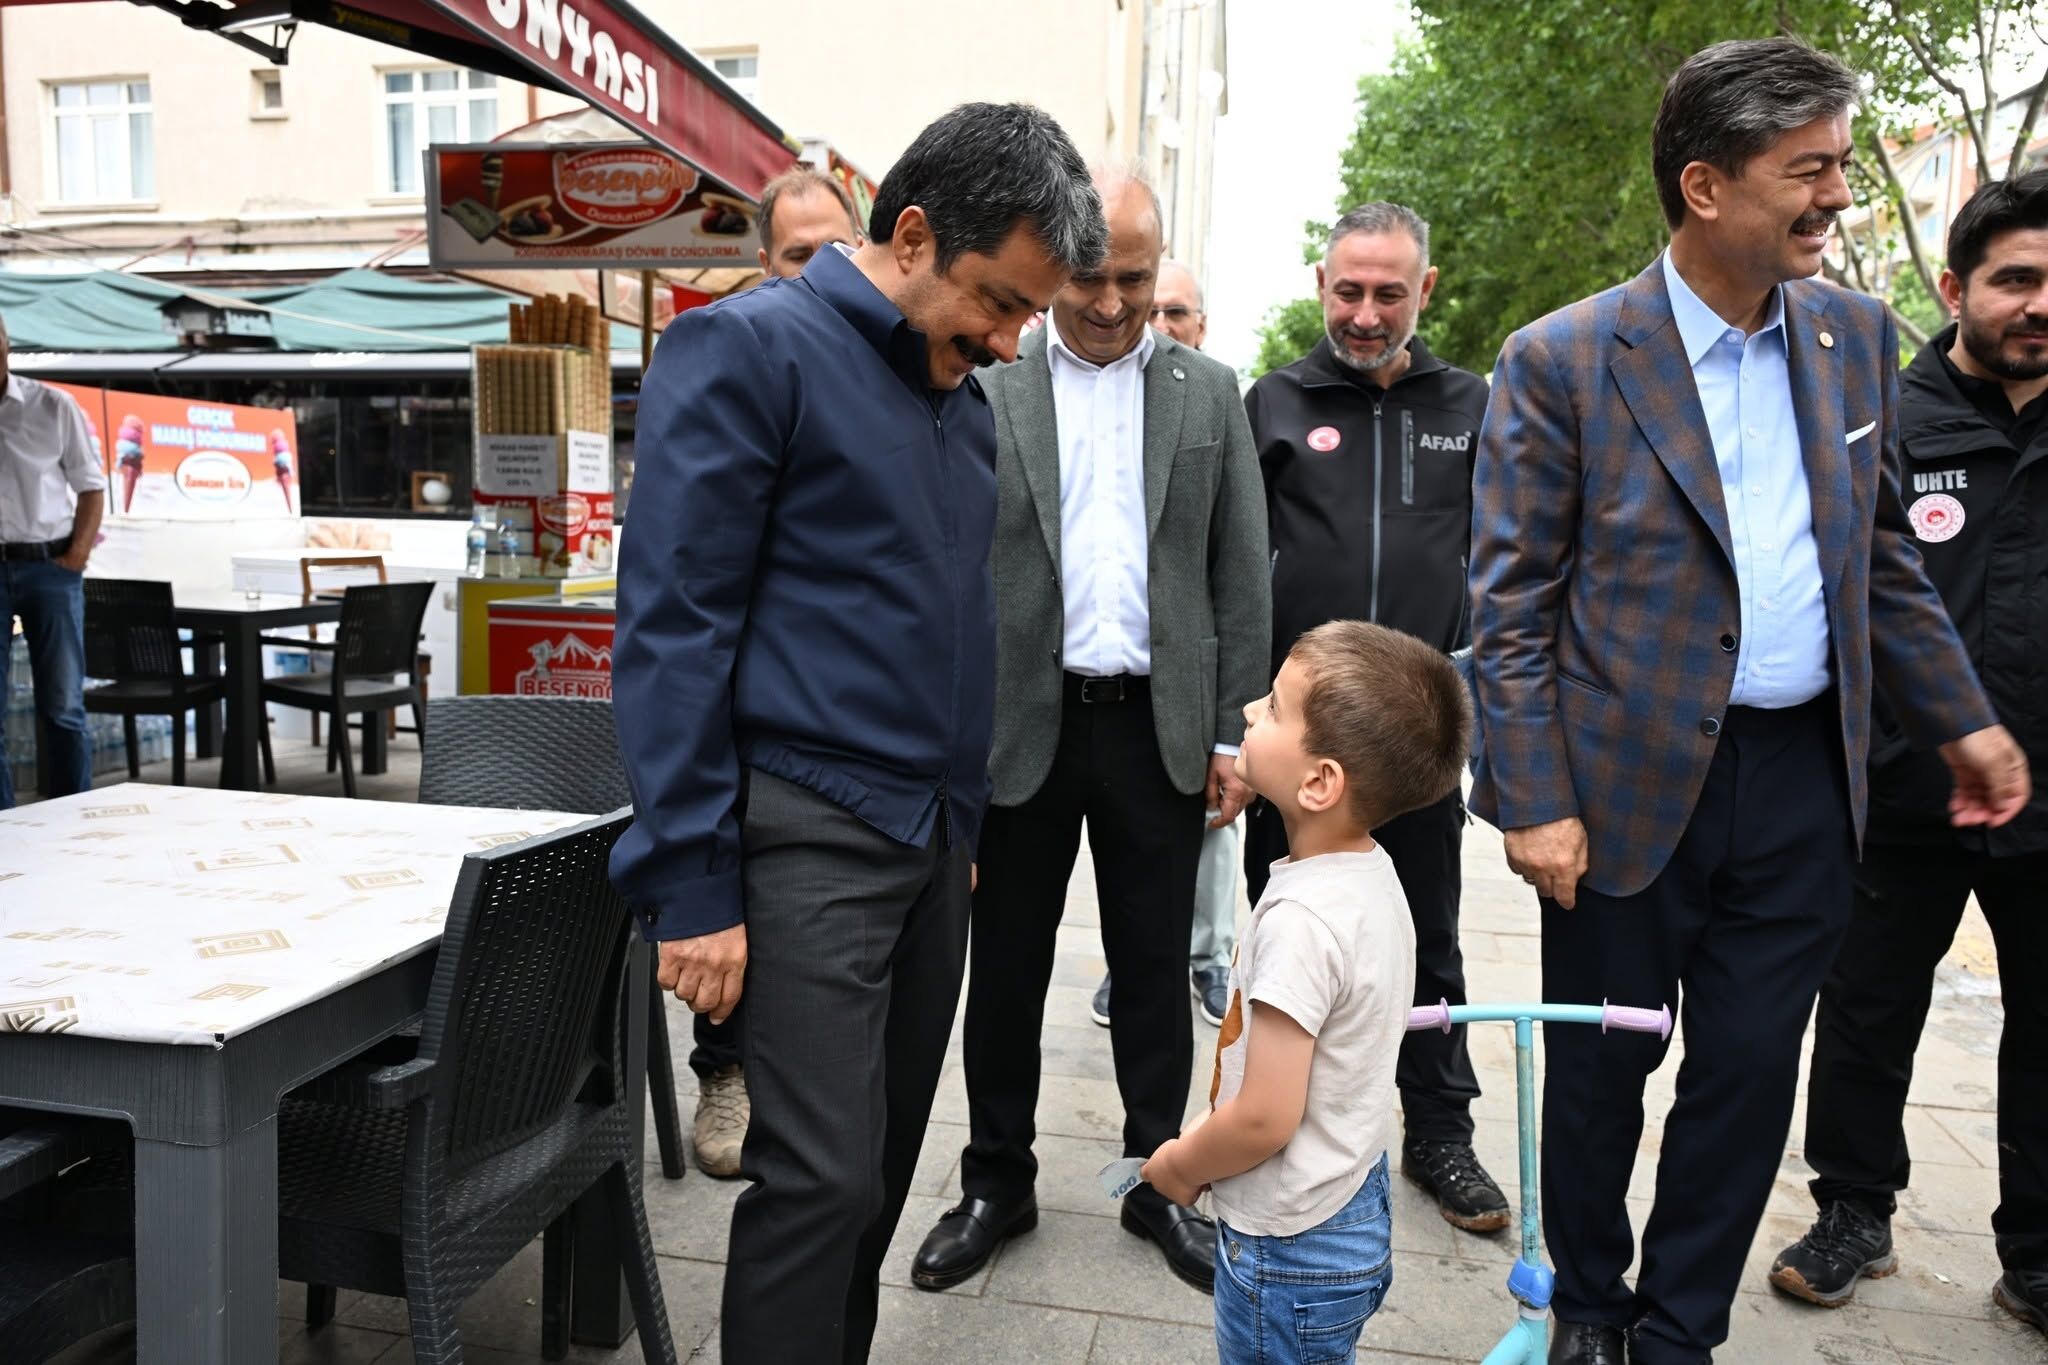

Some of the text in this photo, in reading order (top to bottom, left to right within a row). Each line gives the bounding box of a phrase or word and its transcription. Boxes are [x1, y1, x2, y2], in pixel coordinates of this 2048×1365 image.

[626, 246, 667, 257] DÖVME
[671, 246, 741, 257] DONDURMA
[1420, 432, 1470, 451] AFAD
[1913, 469, 1968, 493] UHTE
[1110, 1175, 1137, 1199] 100
